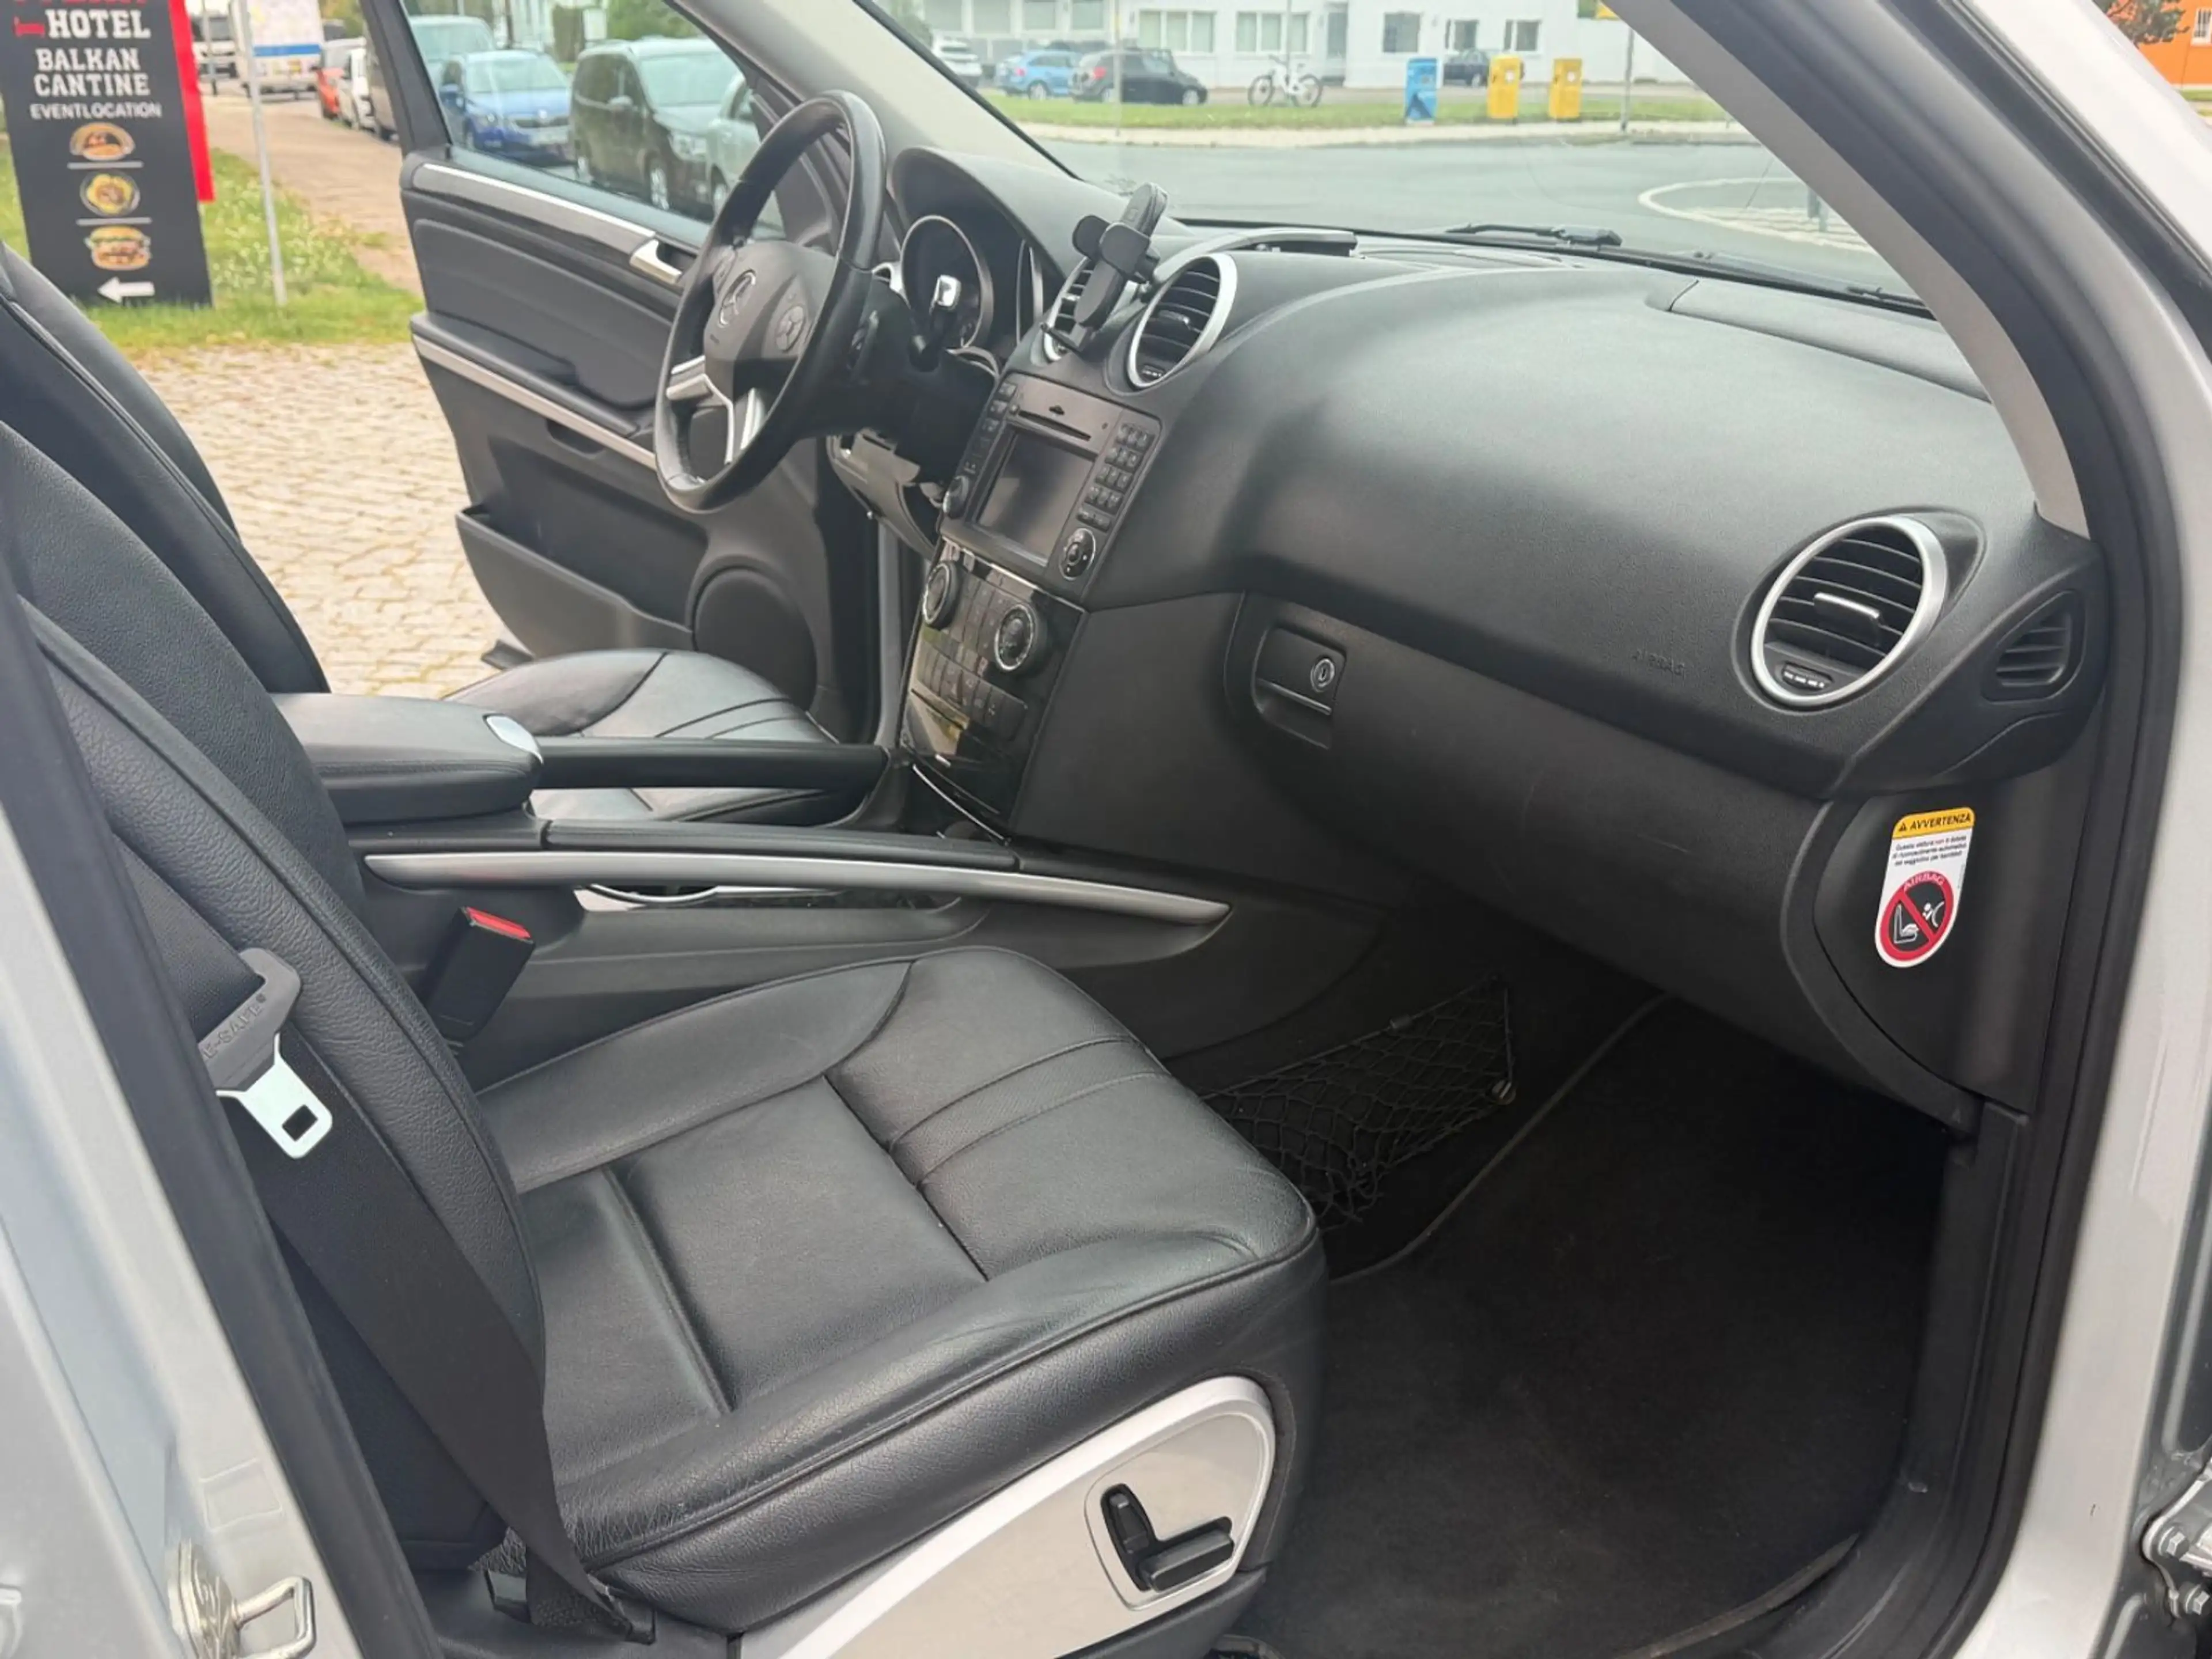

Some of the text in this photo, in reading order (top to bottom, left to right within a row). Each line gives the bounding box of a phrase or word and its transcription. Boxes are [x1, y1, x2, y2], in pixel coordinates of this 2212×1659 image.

[45, 9, 151, 39] HOTEL
[35, 48, 141, 71] BALKAN
[33, 73, 151, 97] CANTINE
[31, 102, 162, 120] EVENTLOCATION
[1910, 813, 1971, 830] AVVERTENZA
